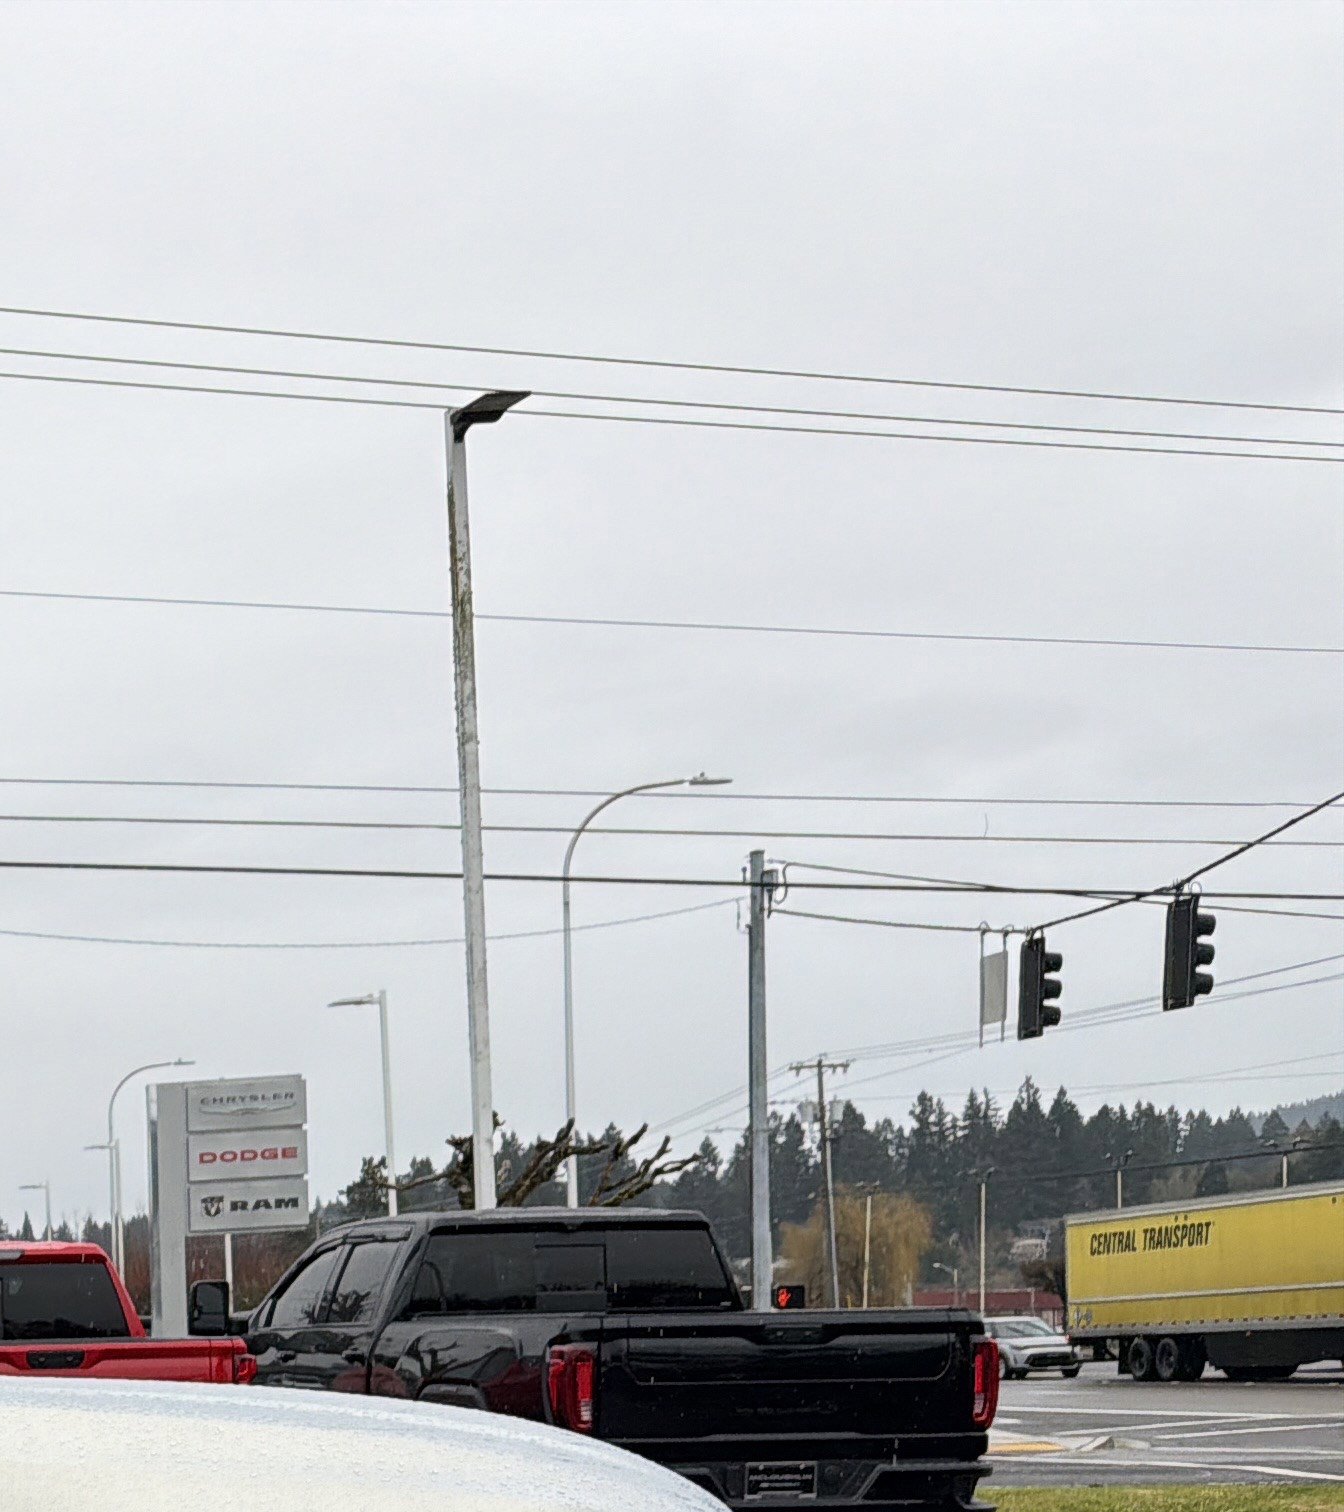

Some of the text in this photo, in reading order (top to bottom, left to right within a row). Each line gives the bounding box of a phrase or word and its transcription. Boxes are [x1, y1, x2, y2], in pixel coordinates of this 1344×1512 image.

[200, 1092, 294, 1105] CHRYSLER
[199, 1146, 298, 1164] DODGE
[229, 1197, 300, 1212] RAM
[1090, 1222, 1212, 1256] CENTRAL TRANSPORT
